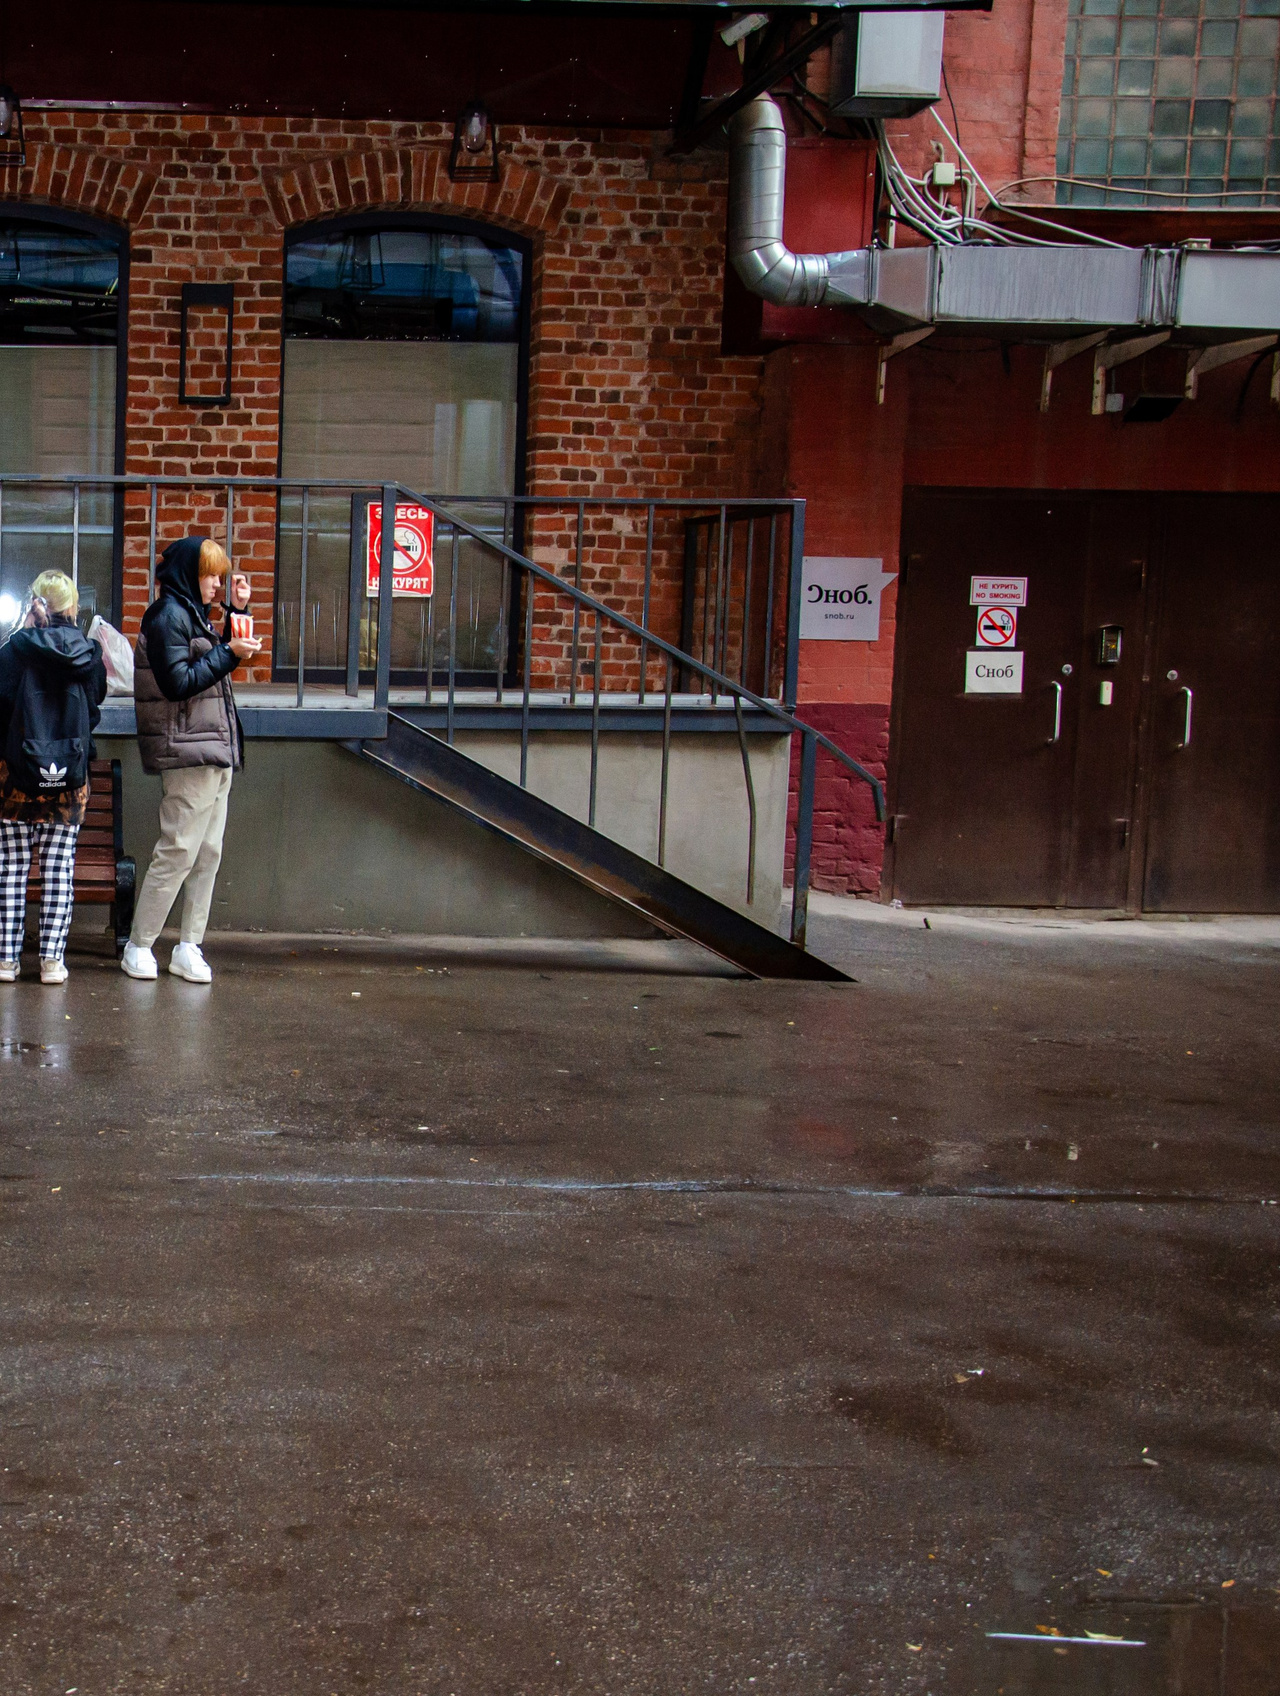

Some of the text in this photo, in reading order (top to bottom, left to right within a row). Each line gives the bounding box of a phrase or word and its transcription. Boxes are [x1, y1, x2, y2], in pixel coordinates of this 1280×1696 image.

[375, 507, 429, 520] ЗЕСЬ
[991, 583, 1019, 591] КУРИТЬ
[989, 592, 1021, 600] SMOKING
[824, 612, 855, 620] snob.ru
[975, 664, 1014, 679] Сноб
